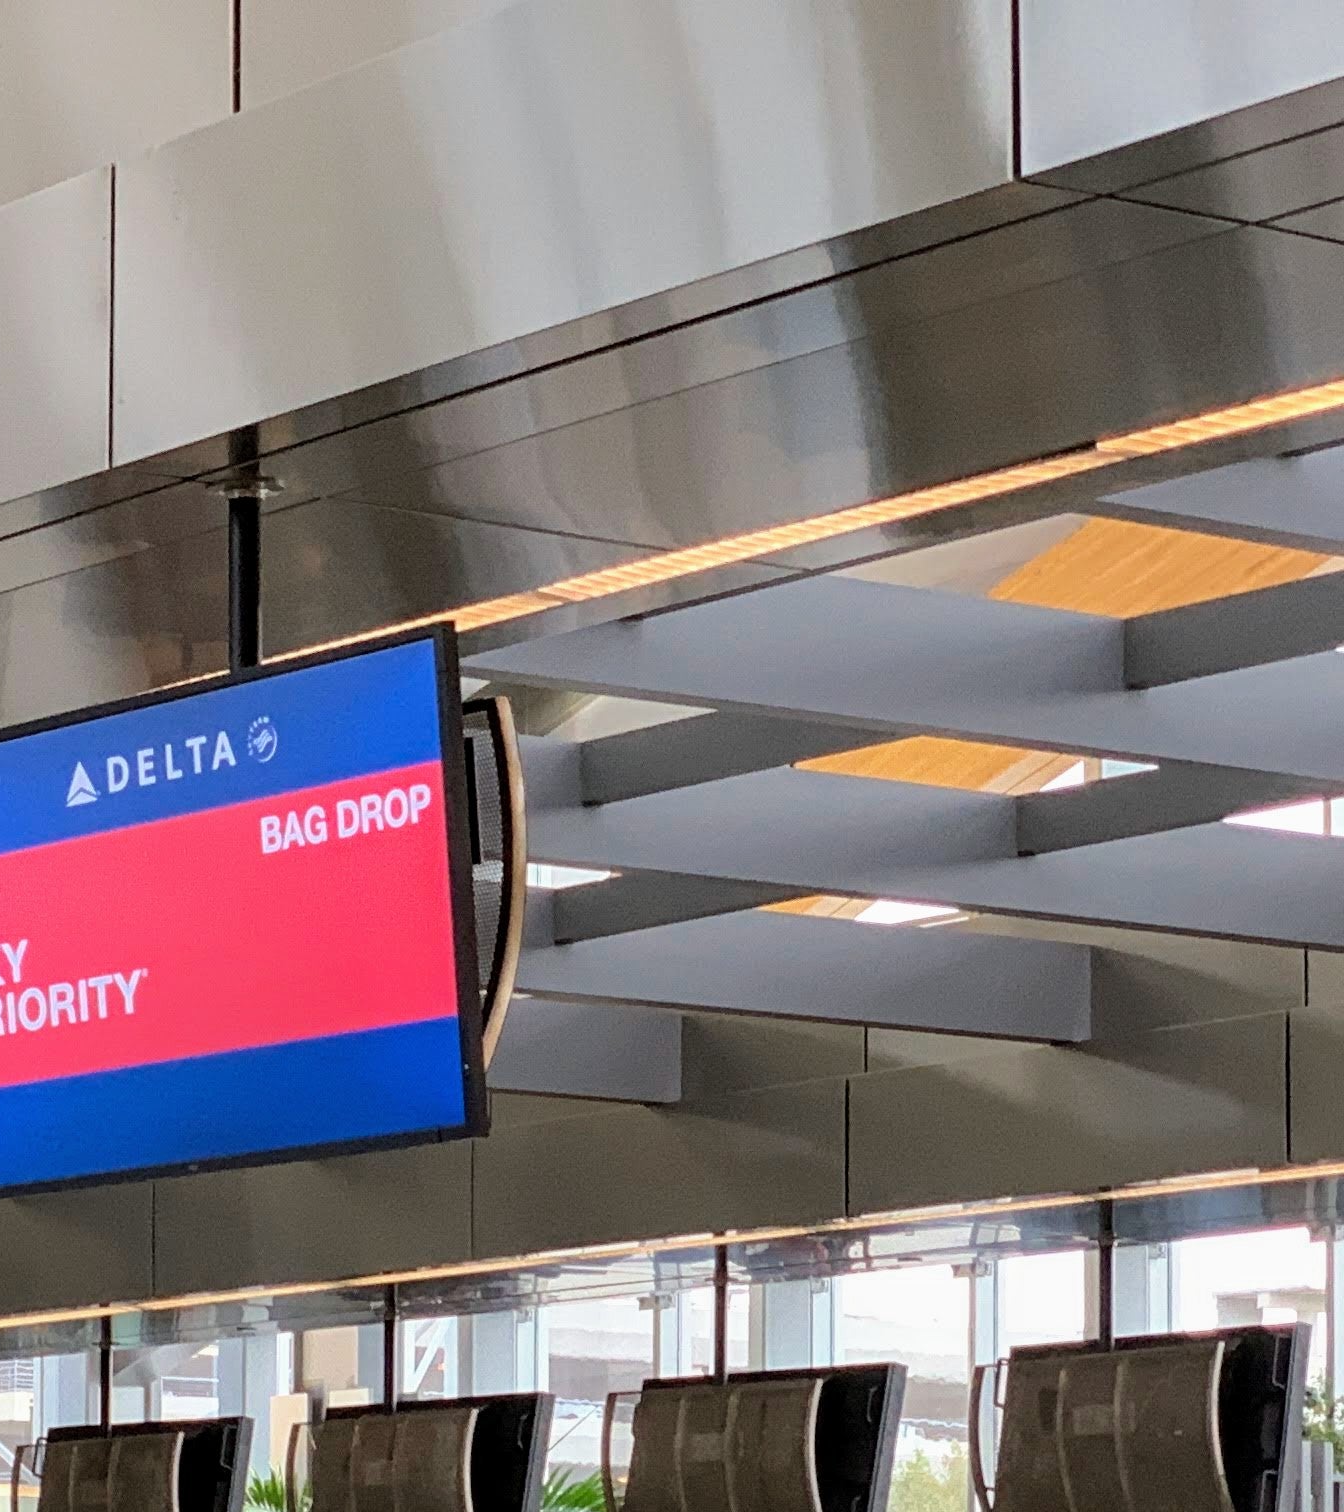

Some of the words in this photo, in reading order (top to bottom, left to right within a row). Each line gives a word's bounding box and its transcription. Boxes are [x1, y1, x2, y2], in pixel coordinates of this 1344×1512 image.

[106, 731, 236, 793] DELTA
[260, 808, 328, 854] BAG
[337, 785, 431, 839] DROP
